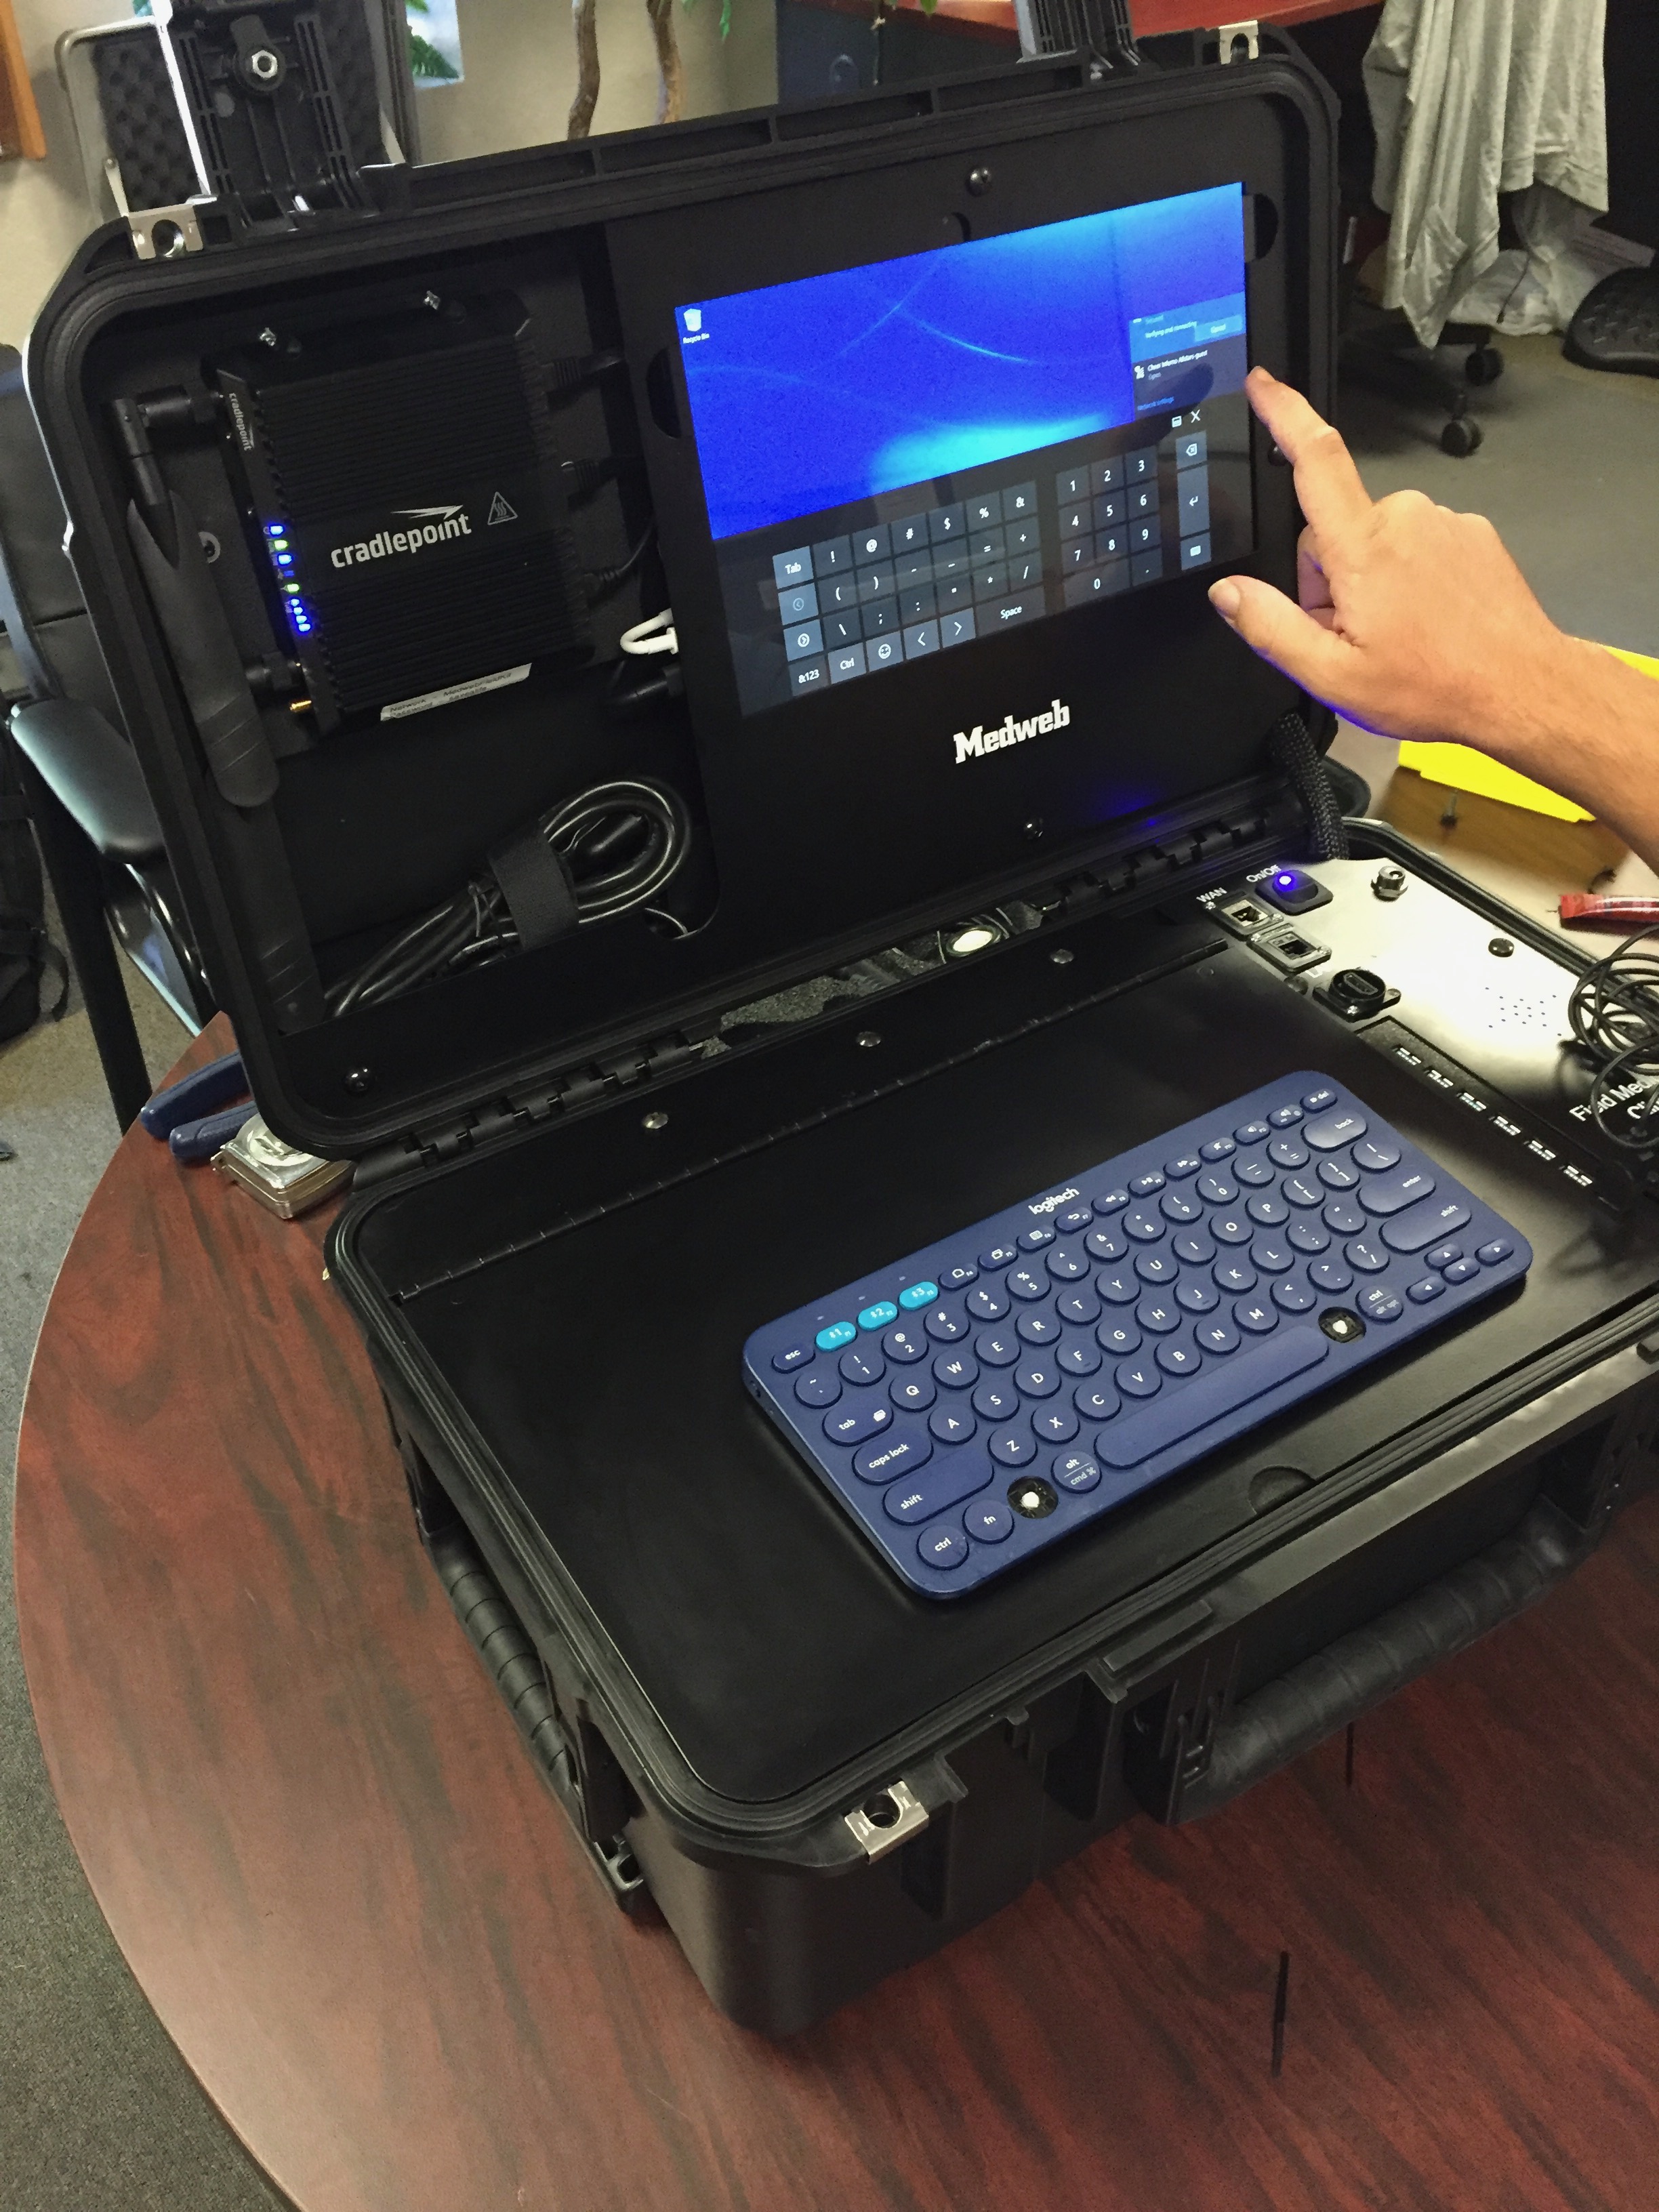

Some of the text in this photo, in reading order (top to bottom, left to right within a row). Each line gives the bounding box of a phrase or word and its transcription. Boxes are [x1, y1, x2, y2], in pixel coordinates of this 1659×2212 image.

[1139, 460, 1144, 471] 3
[1105, 470, 1111, 481] 2
[1071, 480, 1075, 491] 1
[1141, 495, 1147, 506] 6
[1107, 505, 1113, 516] 5
[1072, 516, 1078, 526] 4
[1143, 529, 1148, 539] 9
[331, 514, 472, 568] cradlepoint
[1109, 539, 1115, 550] 8
[1075, 550, 1080, 560] 7
[785, 562, 801, 574] Tab
[1094, 579, 1100, 589] 0
[1001, 607, 1022, 619] Space
[840, 658, 854, 670] Ctrl
[799, 670, 819, 683] &123
[953, 699, 1070, 764] Medweb
[1246, 865, 1282, 882] On/Off
[1196, 887, 1227, 903] WAN
[1570, 1094, 1618, 1122] Fild
[1335, 1119, 1353, 1129] back
[1028, 1187, 1080, 1214] logitech
[1263, 1204, 1270, 1212] P
[1226, 1223, 1237, 1231] O
[1150, 1261, 1162, 1269] U
[1229, 1269, 1242, 1278] K
[1112, 1279, 1122, 1288] Y
[1195, 1290, 1202, 1298] J
[1369, 1290, 1383, 1300] ctrl
[1073, 1300, 1082, 1309] T
[1152, 1309, 1165, 1319] H
[1249, 1309, 1264, 1319] M
[1033, 1322, 1045, 1330] R
[1114, 1330, 1125, 1339] G
[1212, 1330, 1225, 1340] N
[992, 1342, 1003, 1351] E
[785, 1351, 800, 1359] esc
[1073, 1351, 1082, 1361] F
[1173, 1351, 1185, 1361] B
[947, 1361, 962, 1373] W
[1031, 1374, 1043, 1383] D
[1132, 1372, 1143, 1382] V
[906, 1386, 919, 1395] Q
[991, 1395, 1001, 1404] S
[1092, 1395, 1104, 1404] C
[839, 1420, 855, 1429] tab
[949, 1418, 959, 1429] A
[1050, 1417, 1063, 1428] X
[1007, 1440, 1019, 1451] Z
[869, 1443, 909, 1469] caps lock
[1066, 1459, 1079, 1469] alt
[901, 1495, 922, 1509] shift
[983, 1515, 996, 1525] fn
[935, 1538, 951, 1551] ctrl
